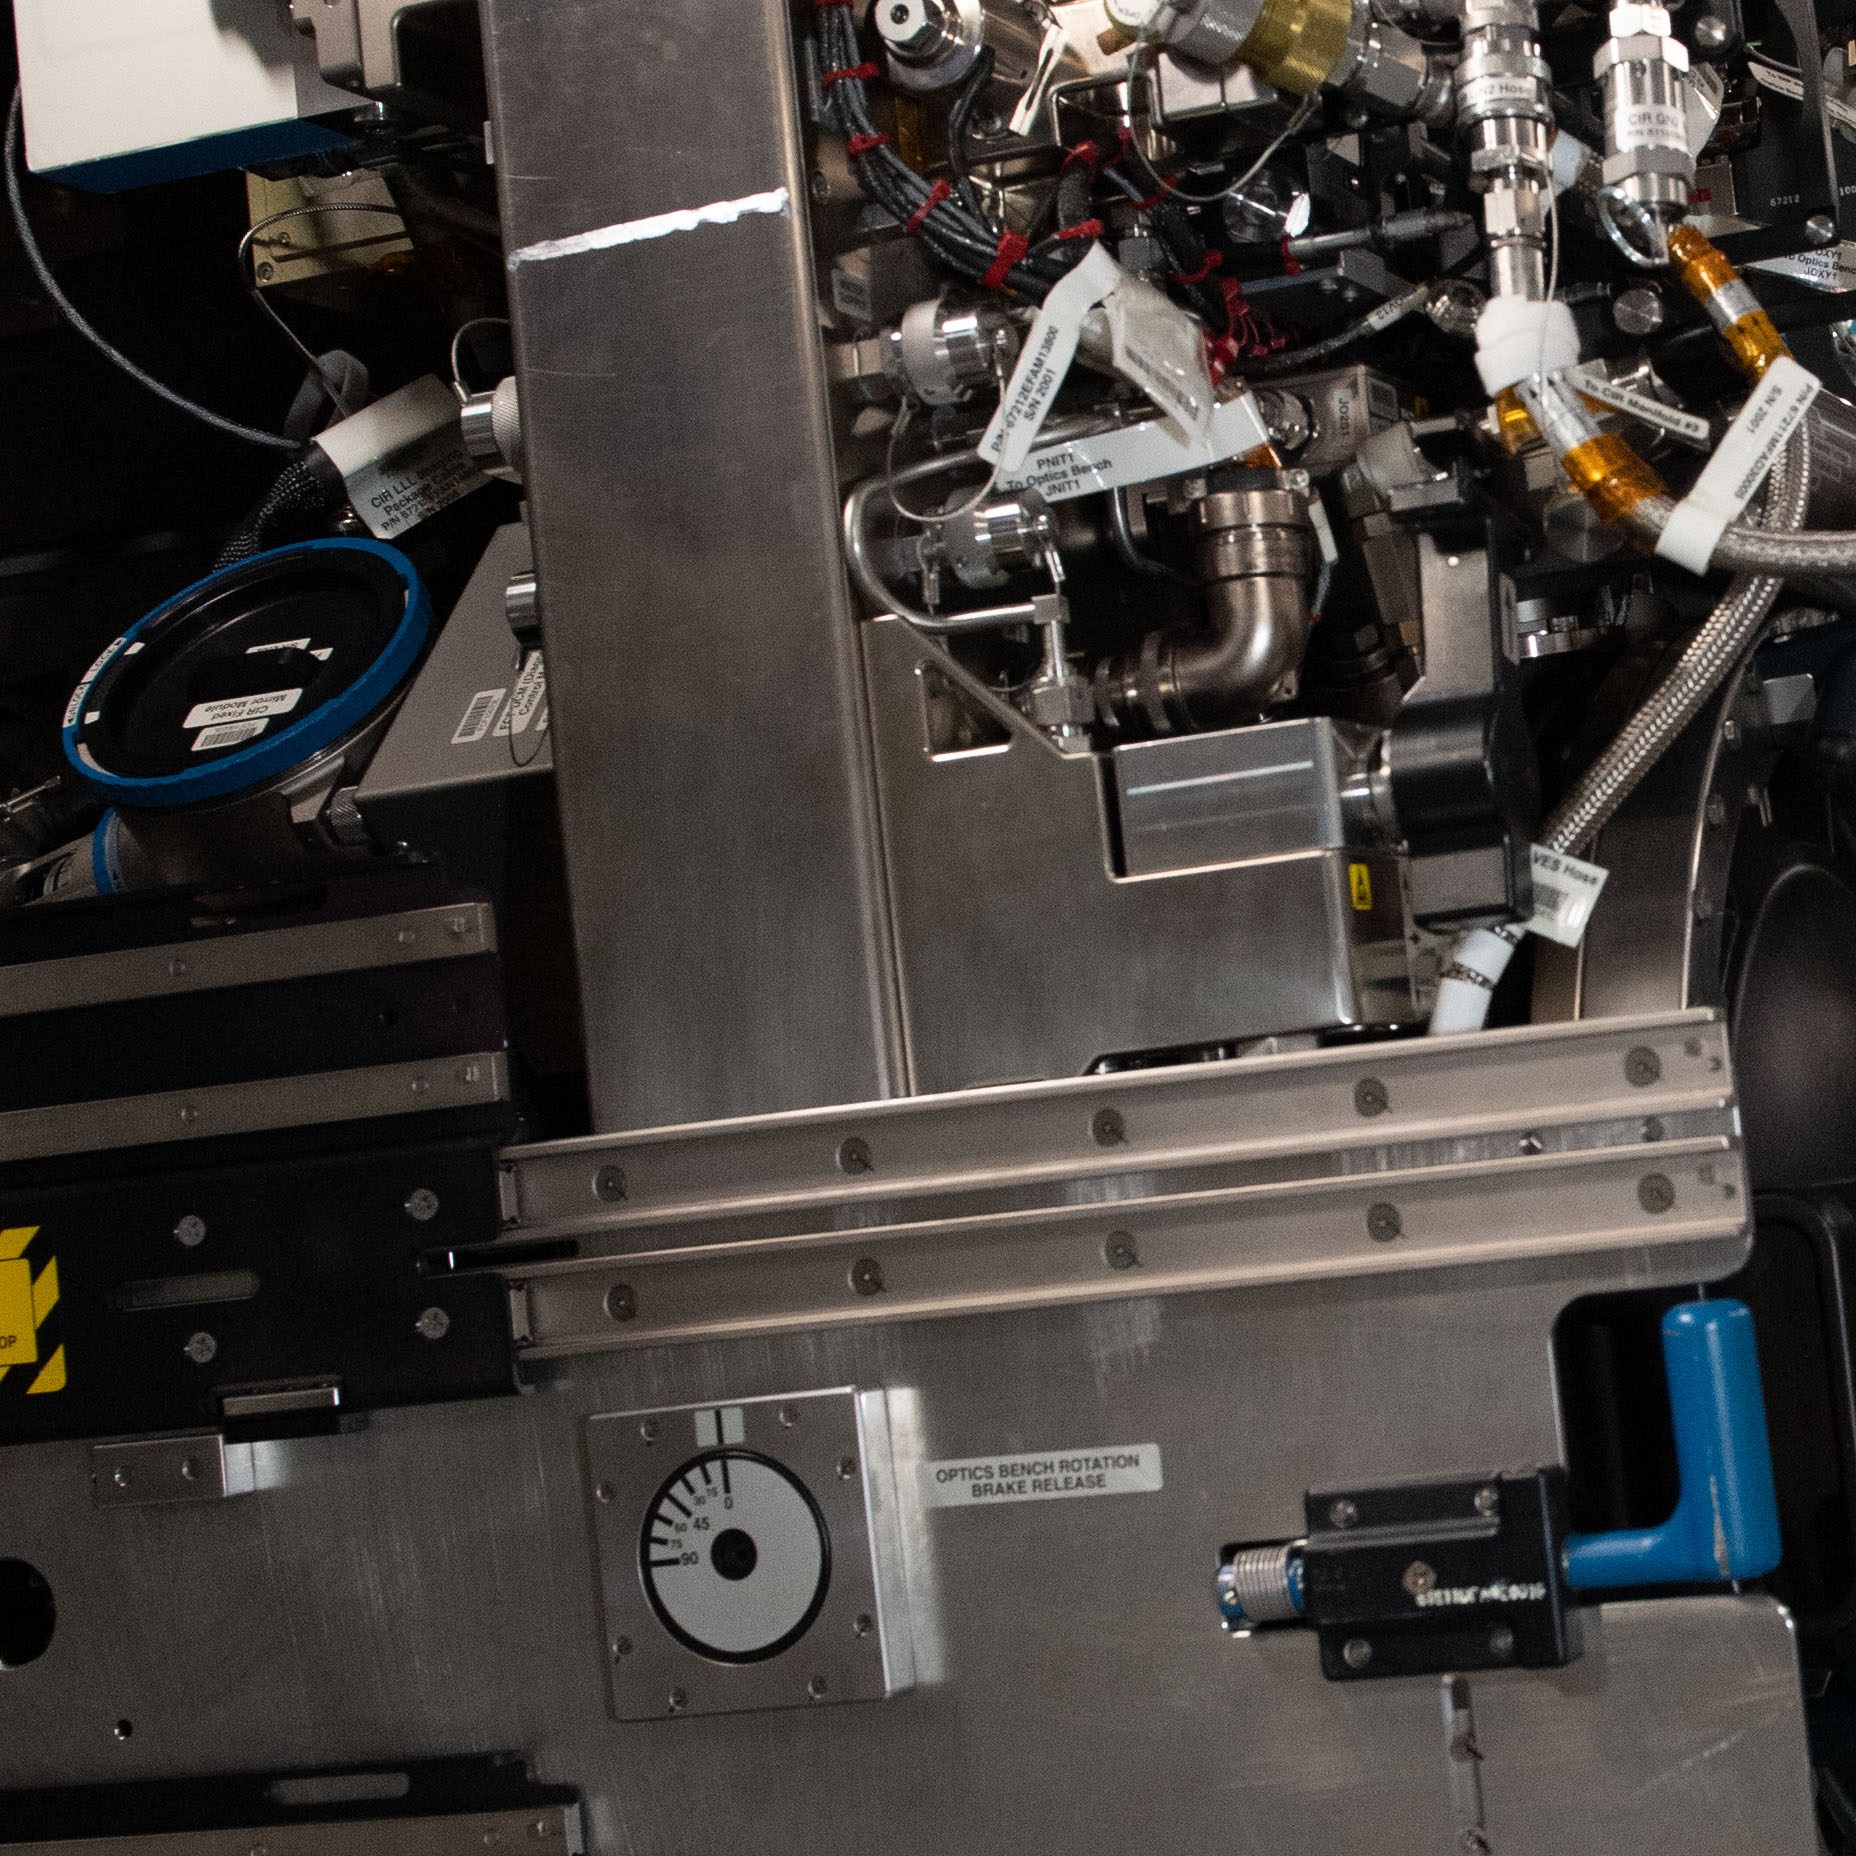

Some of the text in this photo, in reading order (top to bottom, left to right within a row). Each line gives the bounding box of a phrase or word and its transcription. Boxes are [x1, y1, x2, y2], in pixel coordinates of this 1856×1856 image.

[1796, 253, 1830, 268] Optics
[1022, 367, 1058, 422] S/N 2001
[1582, 379, 1683, 427] To CIR Manifold
[1791, 380, 1814, 408] P/N
[1744, 383, 1784, 436] S/N 2001
[1026, 470, 1070, 489] Optics
[1071, 459, 1113, 477] Bench
[1045, 480, 1081, 497] JNIT1
[368, 473, 419, 511] CIR LLL
[382, 477, 435, 519] Package
[203, 693, 288, 713] Mirror Module
[209, 704, 269, 721] CIR Fixed
[518, 678, 542, 719] Control
[1529, 851, 1601, 887] VES Hose
[935, 1452, 1141, 1484] OPTICS BENCH ROTATION
[971, 1473, 1106, 1499] BRAKE RELEASE
[724, 1496, 734, 1510] 0
[692, 1517, 711, 1532] 45
[680, 1551, 699, 1567] 90
